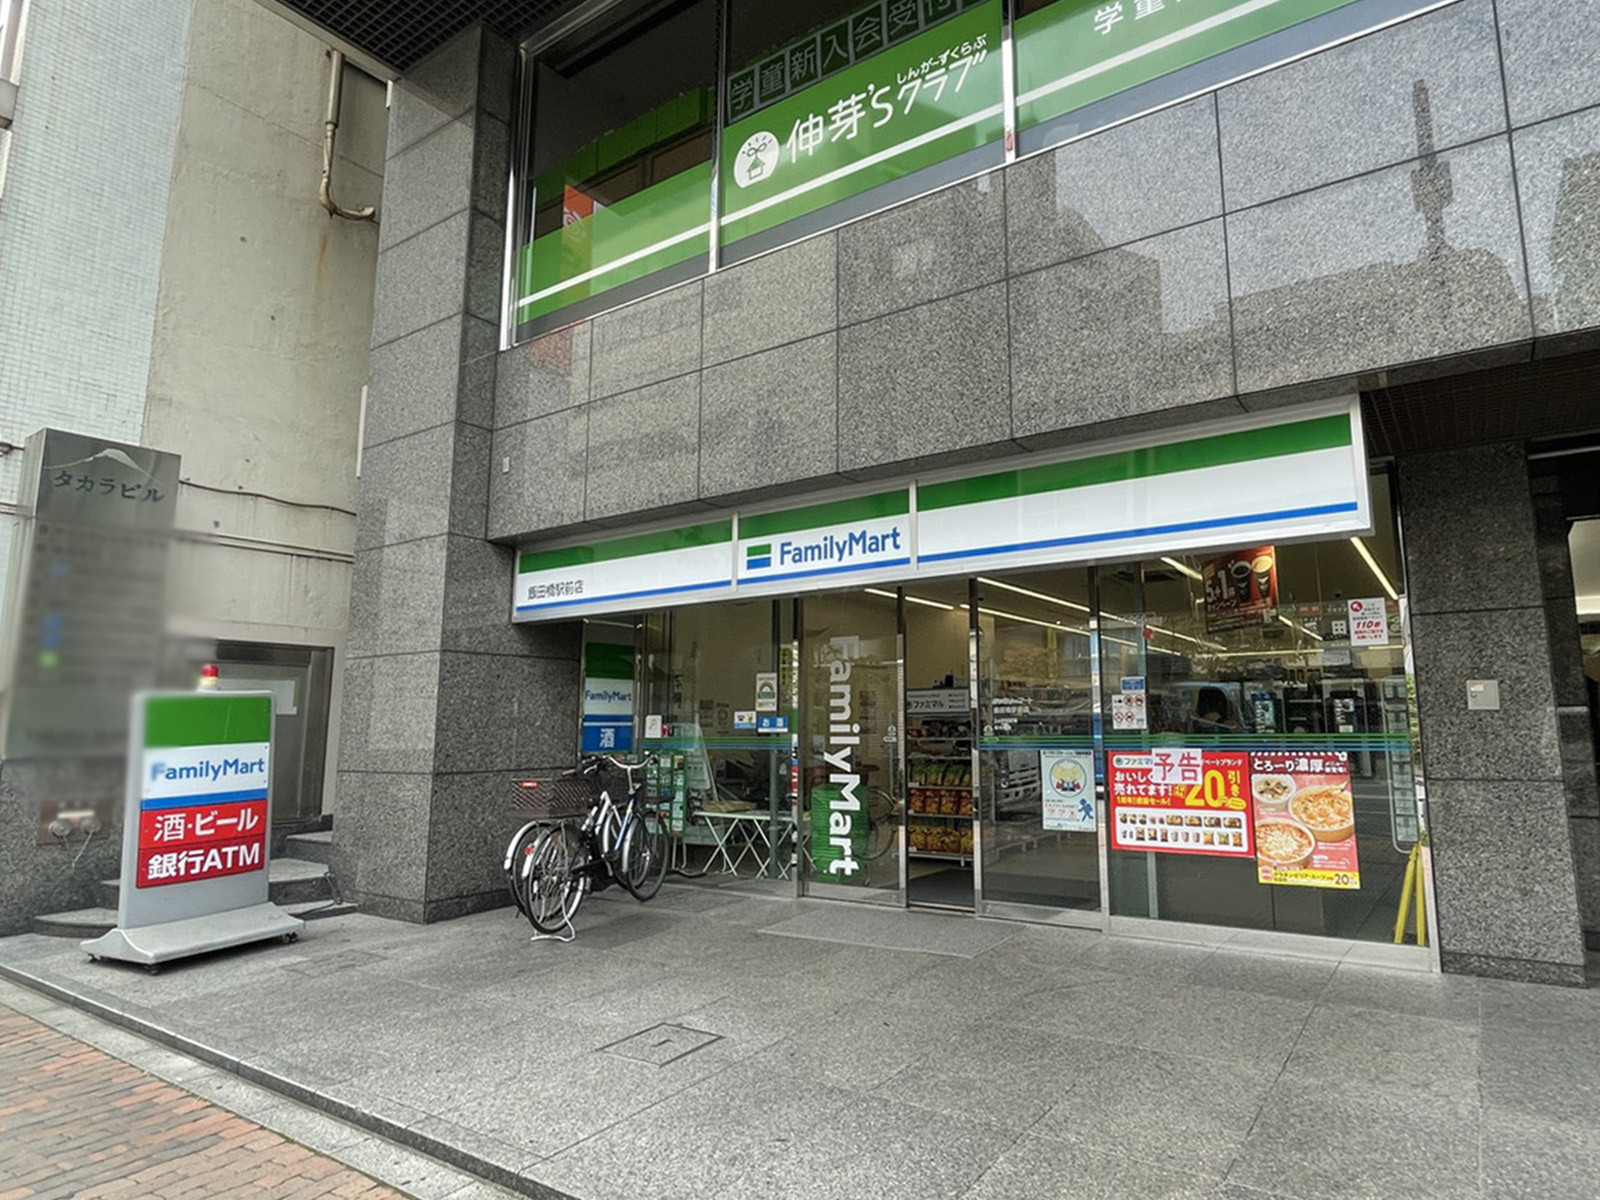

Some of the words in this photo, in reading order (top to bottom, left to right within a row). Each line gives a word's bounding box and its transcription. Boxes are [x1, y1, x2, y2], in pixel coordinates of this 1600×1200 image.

[1094, 0, 1181, 35] 学童
[53, 470, 164, 503] タカラビル
[779, 527, 901, 566] FamilyMart
[585, 690, 632, 702] FamilyMart
[599, 728, 615, 748] 酒
[151, 757, 265, 782] FamilyMart
[824, 635, 861, 876] FamilyMart
[1153, 752, 1201, 782] 予告
[1185, 769, 1225, 808] 20
[147, 843, 260, 880] 銀行ATM
